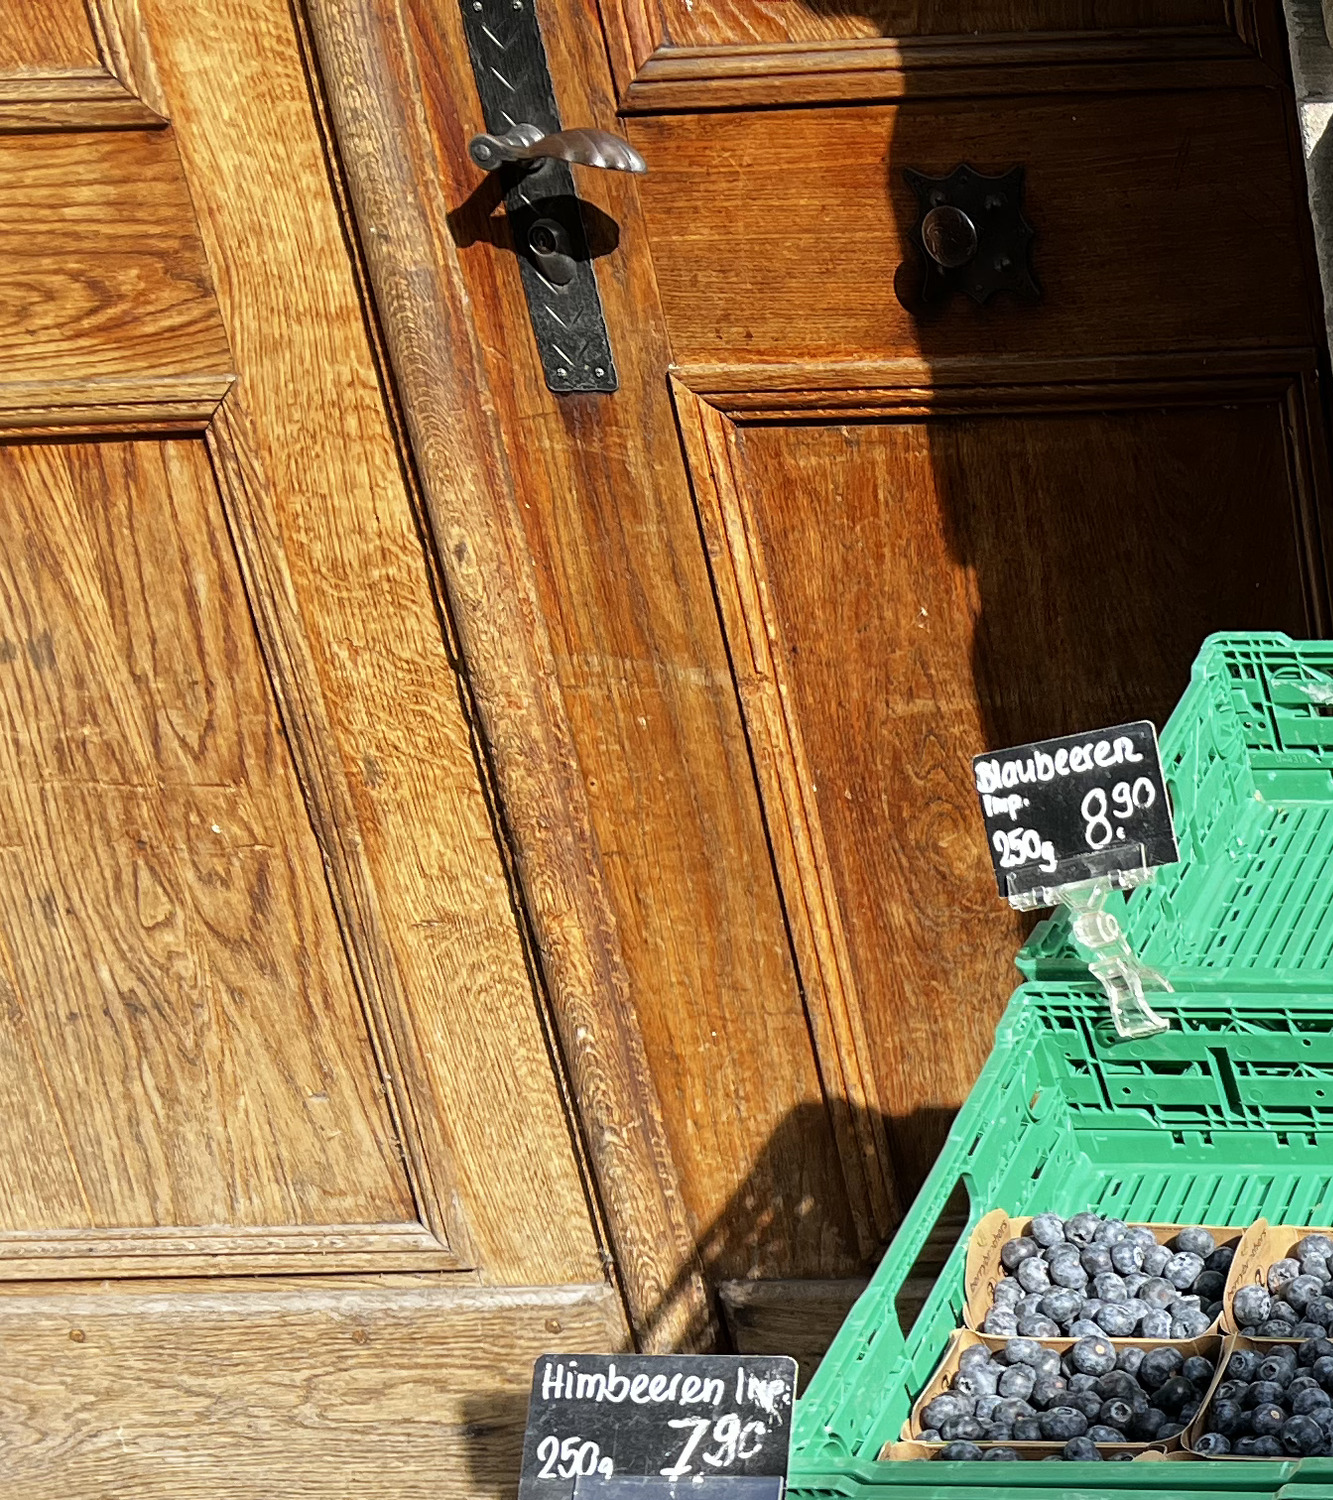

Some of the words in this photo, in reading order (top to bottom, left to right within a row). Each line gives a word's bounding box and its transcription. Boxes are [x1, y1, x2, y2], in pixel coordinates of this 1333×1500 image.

[975, 736, 1143, 793] Blaubeeren
[982, 794, 1030, 821] Imp.
[993, 828, 1057, 872] 250g
[542, 1360, 724, 1405] Himbeeren
[537, 1435, 614, 1480] 250g
